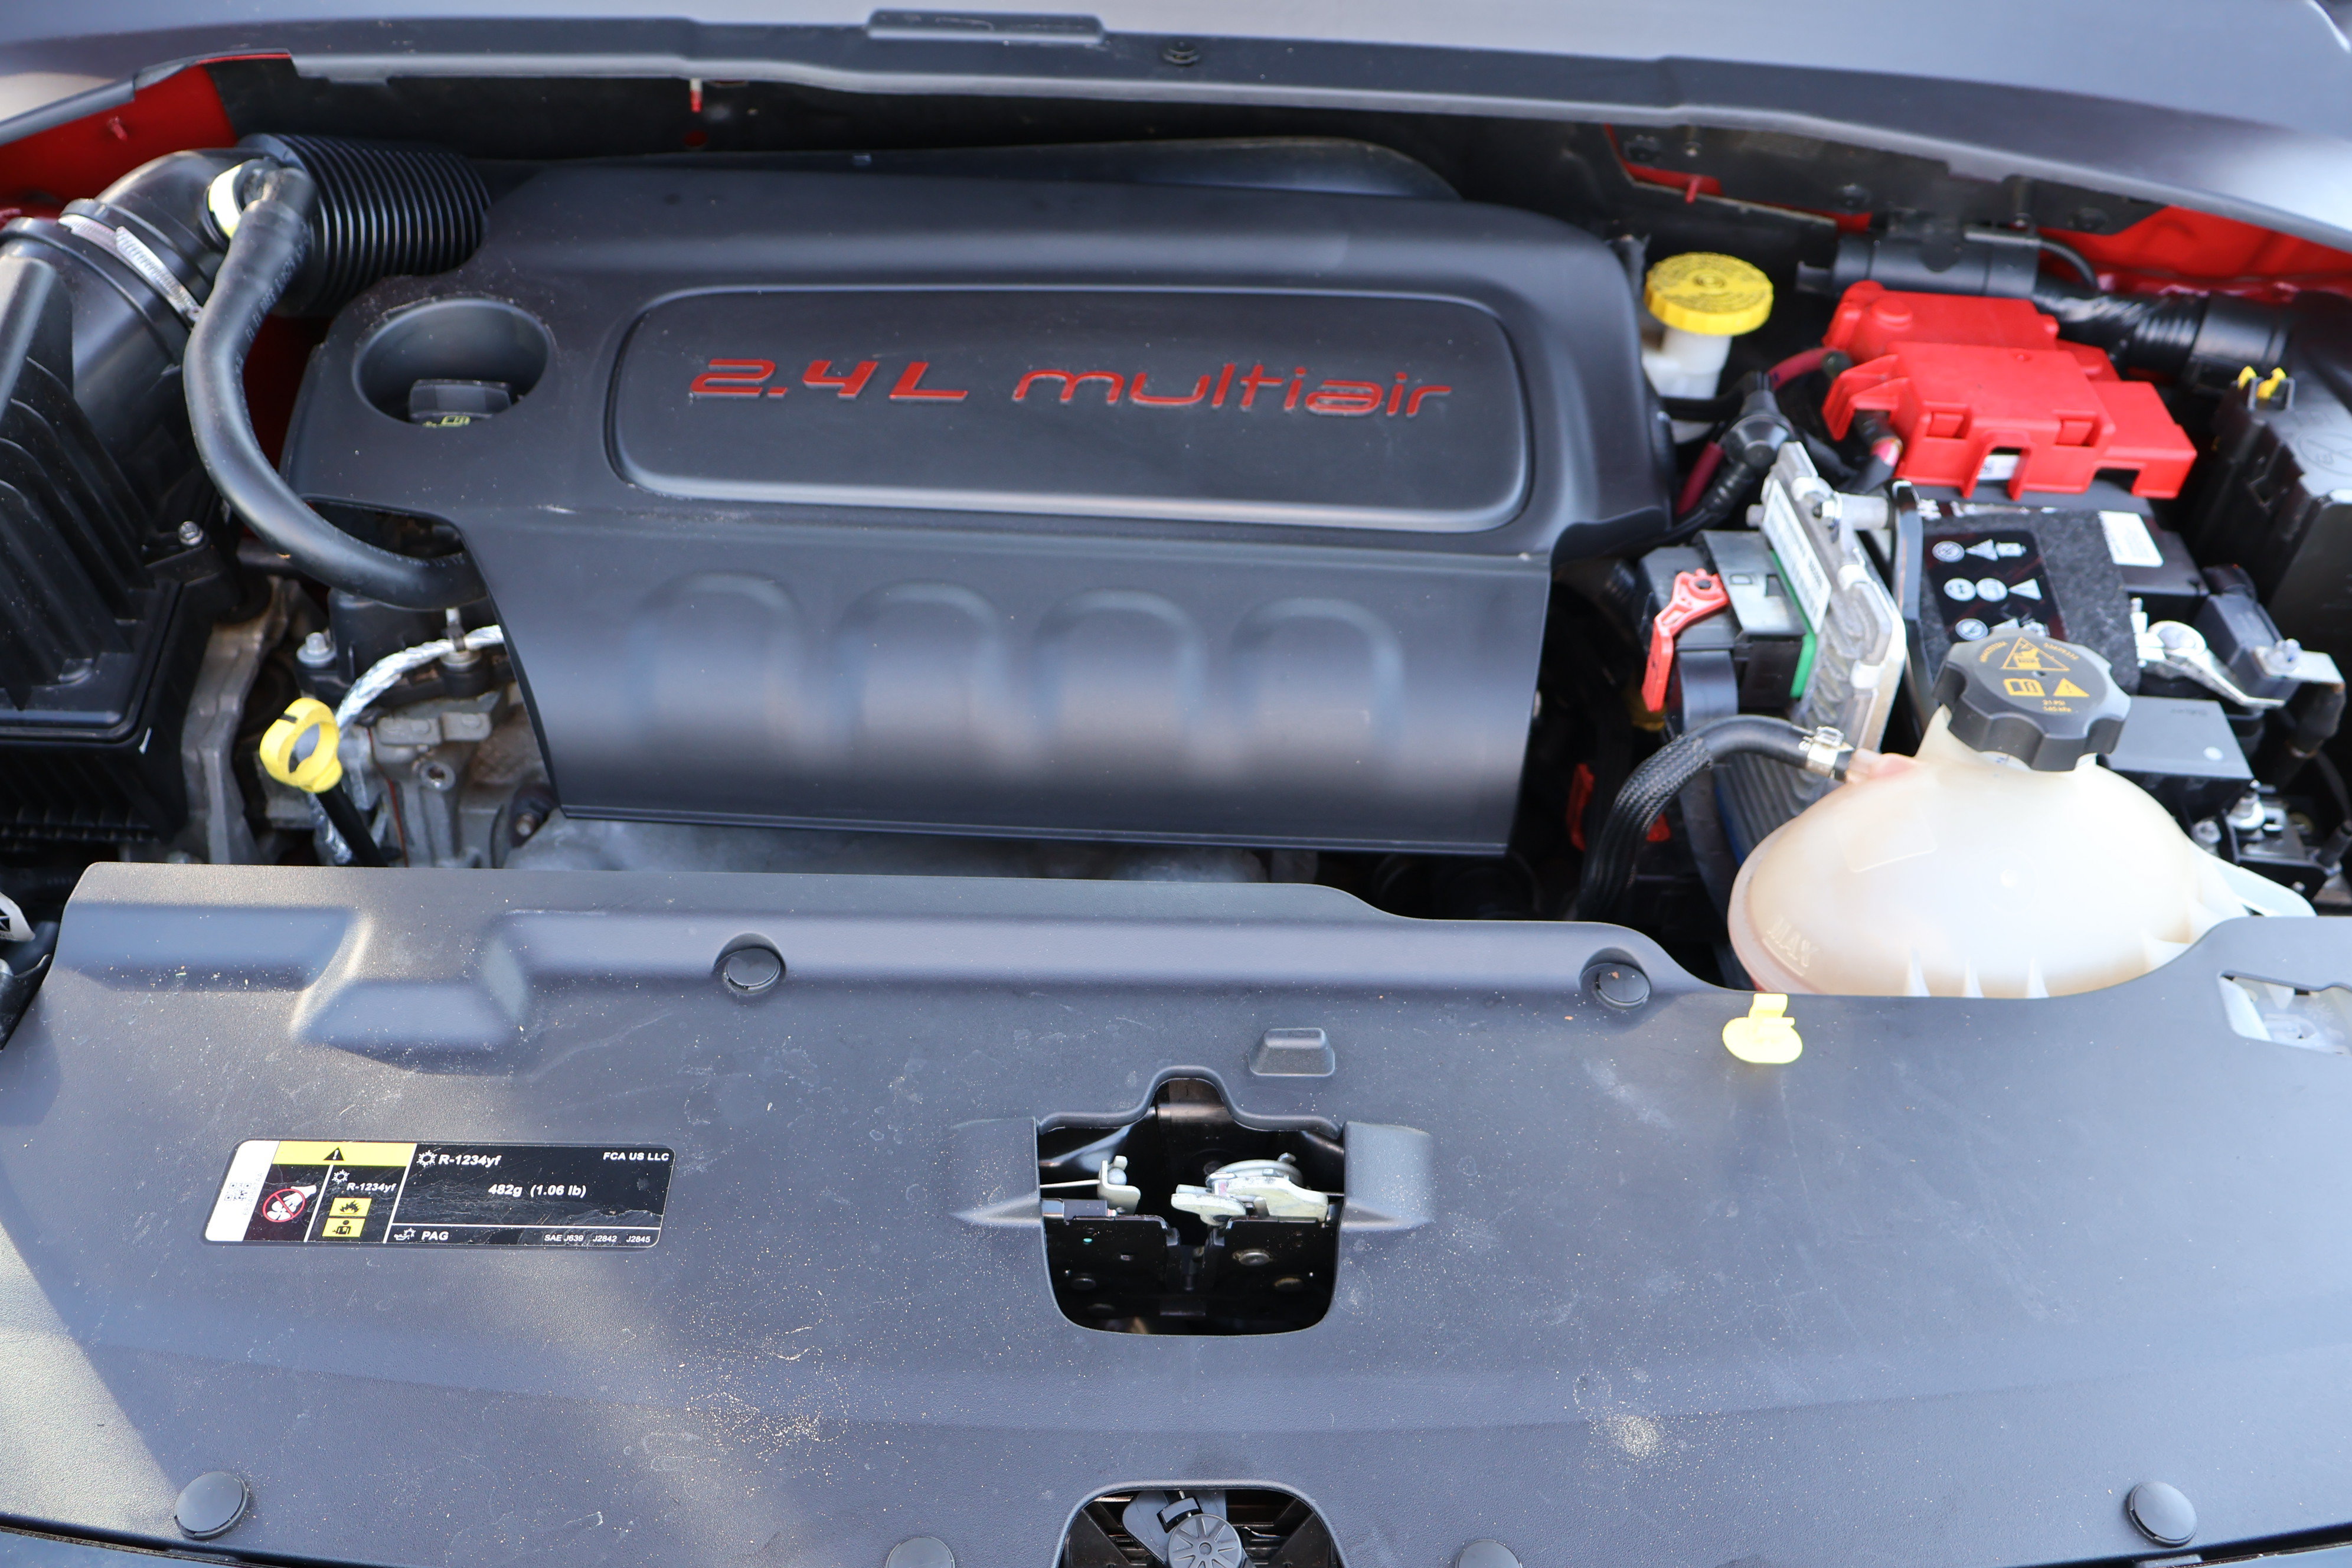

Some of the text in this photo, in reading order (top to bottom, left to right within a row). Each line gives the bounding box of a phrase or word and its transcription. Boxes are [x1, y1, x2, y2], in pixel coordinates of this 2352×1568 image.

[1012, 362, 1452, 416] multiair
[1766, 916, 1820, 968] MAX
[438, 1154, 502, 1168] R-1234yf
[603, 1152, 669, 1161] FCA US LLC
[346, 1182, 397, 1193] R-1234yf
[488, 1184, 587, 1198] 482g (1.06 lb)
[421, 1231, 449, 1241] PAG
